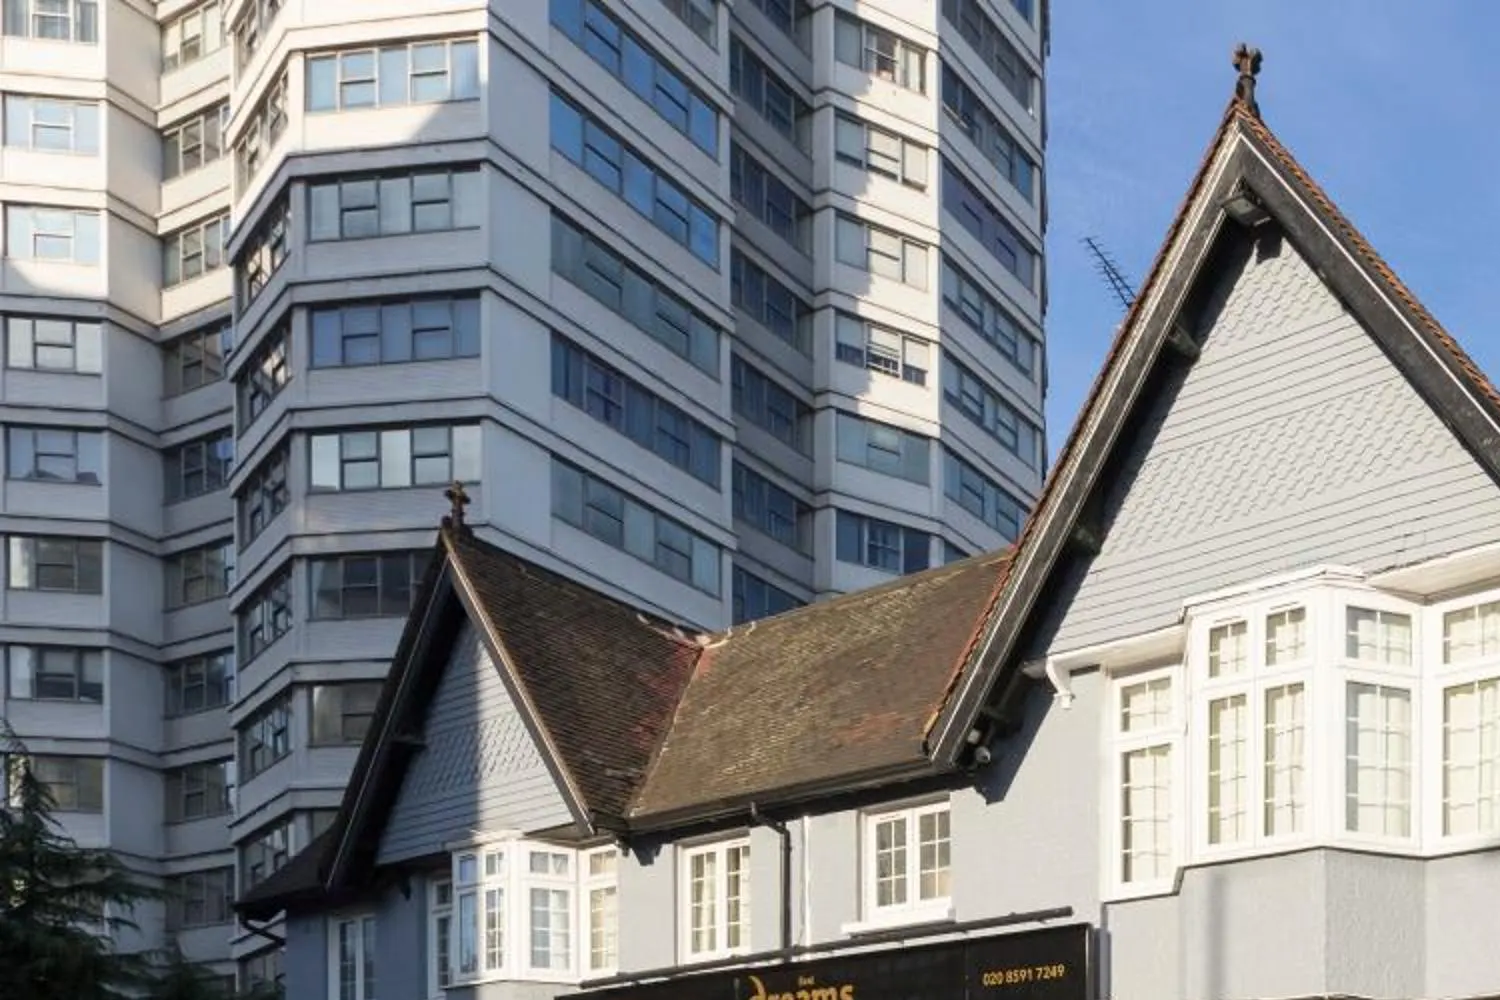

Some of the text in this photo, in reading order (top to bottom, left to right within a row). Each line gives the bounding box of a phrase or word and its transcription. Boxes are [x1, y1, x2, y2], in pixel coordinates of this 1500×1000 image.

[983, 963, 1065, 986] 020 8591 7249
